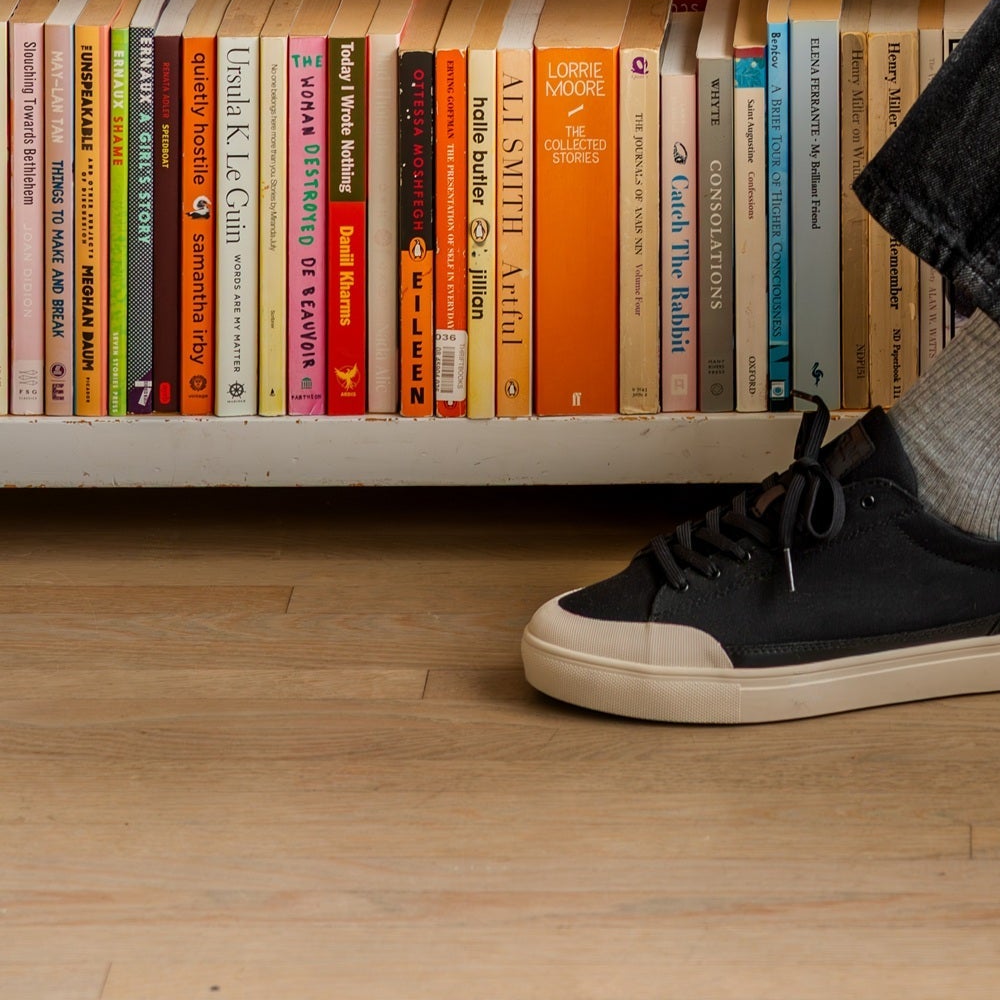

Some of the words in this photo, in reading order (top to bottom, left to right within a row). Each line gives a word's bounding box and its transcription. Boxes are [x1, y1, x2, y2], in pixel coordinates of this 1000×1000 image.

[22, 41, 37, 94] Slouching
[291, 54, 324, 68] THE
[339, 41, 355, 81] Today
[447, 60, 455, 93] ERVING
[548, 62, 604, 79] LORRIE
[811, 38, 820, 74] ELENA
[81, 51, 93, 151] UNSPEAKABLE
[113, 50, 125, 109] ERNAUX
[191, 52, 209, 116] quietly
[227, 47, 251, 116] Ursula
[502, 72, 524, 125] ALI
[545, 80, 606, 97] MOORE
[24, 97, 37, 144] Towards
[301, 75, 316, 136] WOMAN
[341, 94, 355, 135] Wrote
[412, 68, 424, 138] OTTESSA
[447, 96, 455, 138] GOFFMAN
[473, 97, 488, 144] halle
[711, 78, 721, 126] WHYTE
[747, 99, 755, 120] Saint
[811, 77, 820, 136] FERRANTE
[51, 112, 64, 144] TAN
[112, 116, 124, 167] SHAME
[227, 124, 250, 144] K.
[544, 138, 607, 152] COLLECTED
[564, 125, 586, 138] THE
[746, 121, 756, 163] Augustine
[193, 123, 209, 184] hostile
[226, 153, 250, 180] Le
[339, 140, 355, 193] Nothing
[447, 143, 455, 162] THE
[552, 152, 600, 164] STORIES
[809, 144, 820, 158] My
[24, 148, 37, 205] Bethlehem
[52, 160, 64, 204] THINGS
[298, 144, 321, 246] DESTROYED
[412, 143, 424, 231] MOSHFEGH
[447, 164, 455, 231] PRESENTATION
[473, 150, 488, 205] butler
[502, 137, 524, 236] SMITH
[747, 170, 756, 219] Confessions
[811, 160, 821, 197] Brilliant
[52, 209, 64, 224] TO
[226, 188, 250, 243] Guin
[672, 175, 690, 232] Catch
[812, 199, 821, 229] Friend
[52, 229, 64, 264] MAKE
[339, 226, 354, 266] Daniil
[448, 233, 455, 246] OF
[710, 159, 724, 309] CONSOLATIONS
[193, 233, 208, 322] samantha
[234, 254, 242, 290] WORDS
[301, 257, 317, 276] DE
[447, 272, 455, 281] IN
[672, 239, 690, 278] The
[52, 268, 64, 294] AND
[81, 265, 94, 328] MEGHAN
[339, 271, 354, 325] Kharms
[468, 268, 488, 321] jillian
[501, 260, 524, 346] Artful
[52, 299, 65, 337] BREAK
[234, 316, 241, 330] MY
[300, 286, 318, 368] BEAUVOIR
[446, 284, 455, 330] EVERYDAY
[672, 286, 690, 352] Rabbit
[81, 331, 94, 372] DAUM
[190, 329, 208, 364] irby
[410, 271, 425, 405] EILEEN
[748, 356, 758, 394] OXFORD
